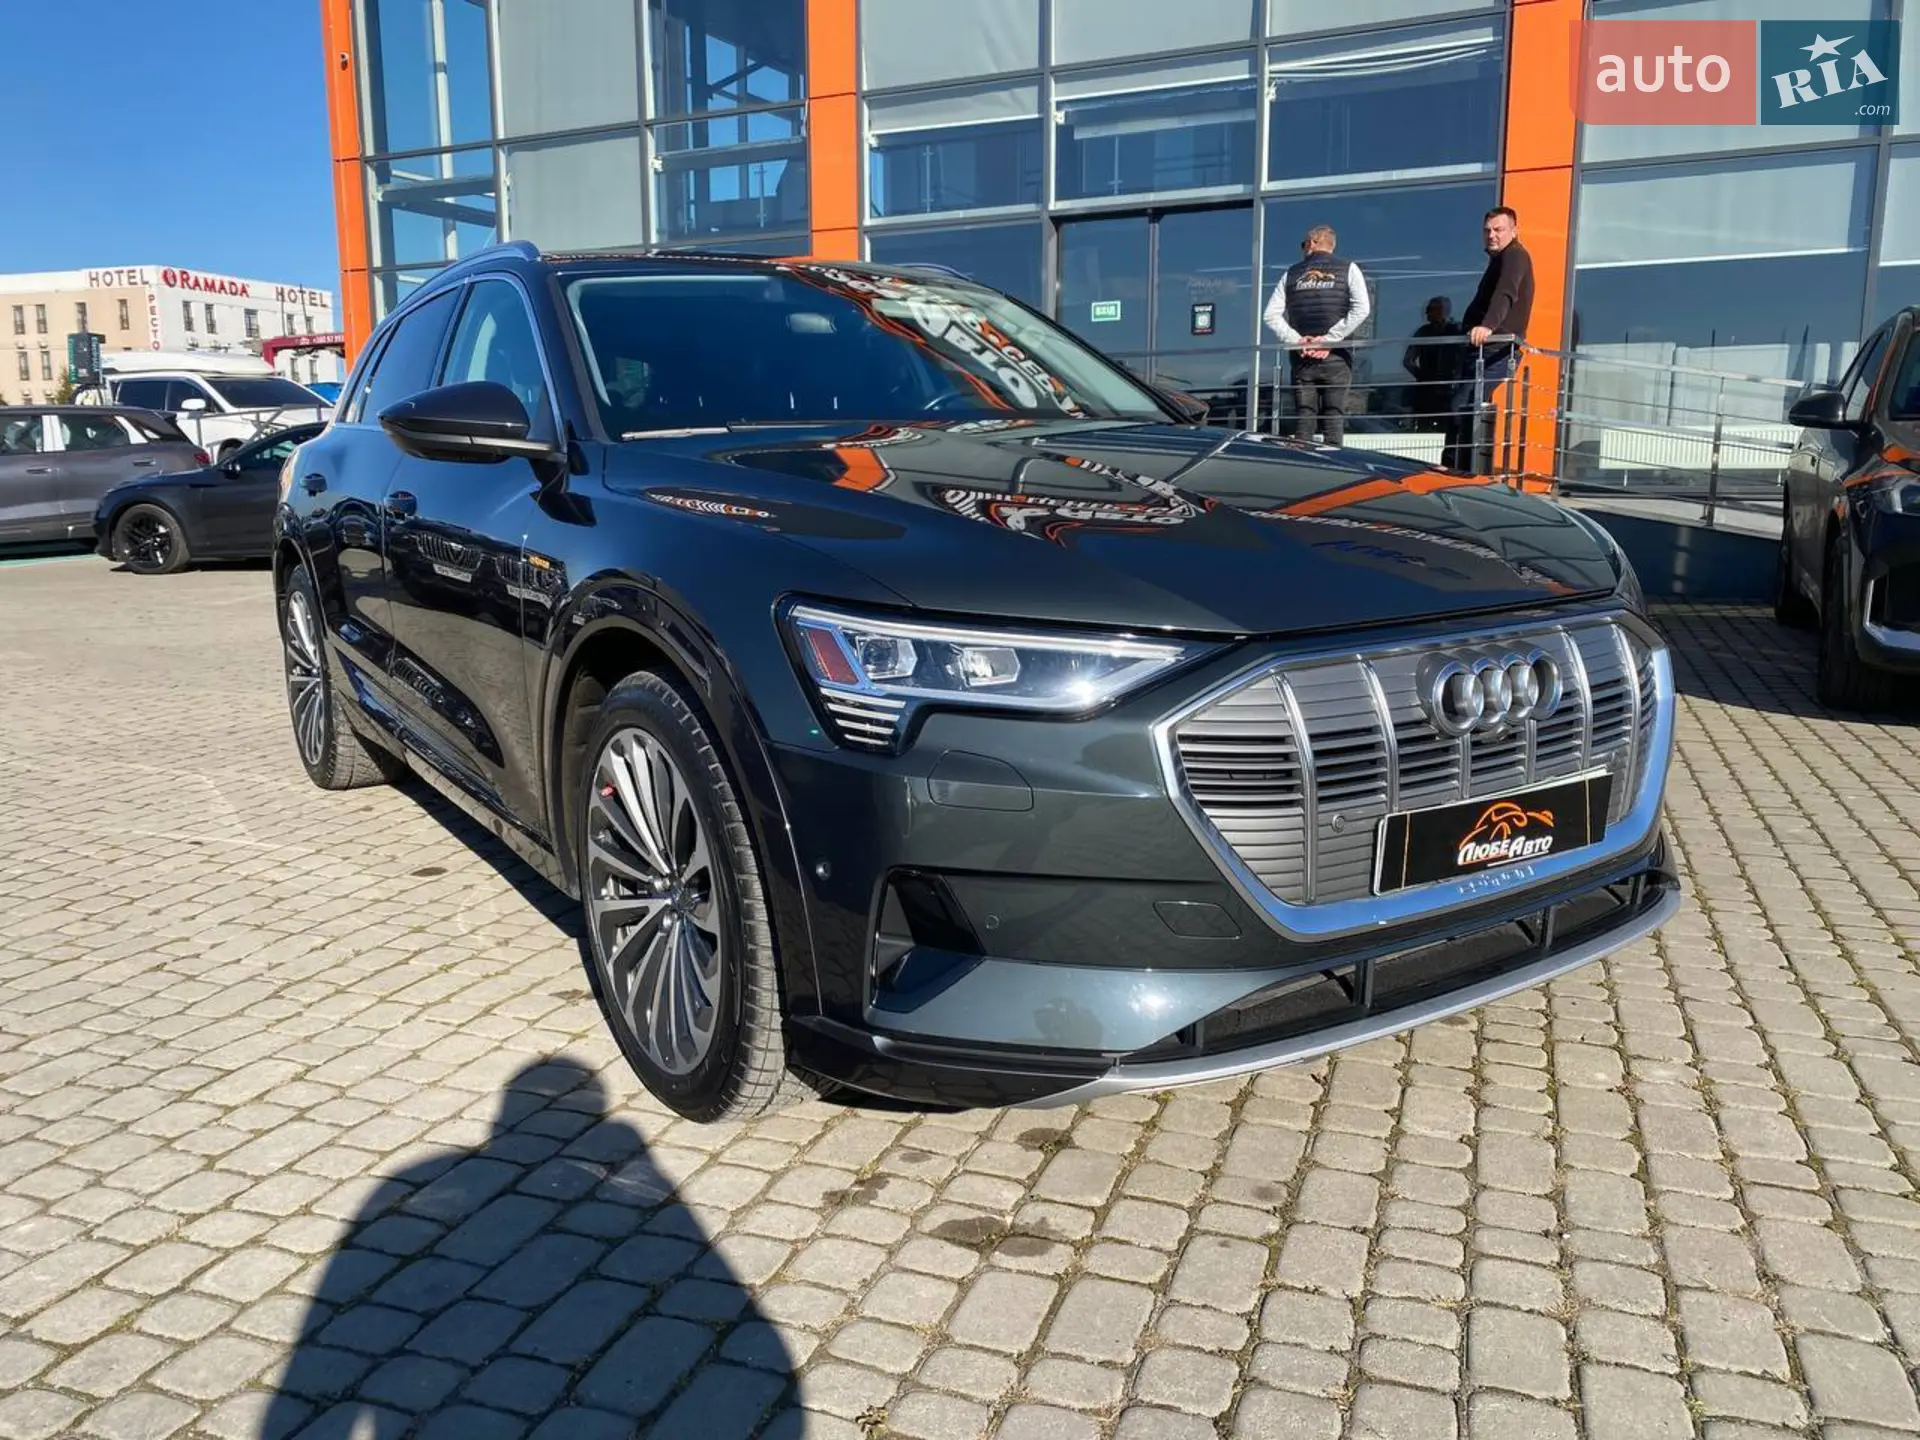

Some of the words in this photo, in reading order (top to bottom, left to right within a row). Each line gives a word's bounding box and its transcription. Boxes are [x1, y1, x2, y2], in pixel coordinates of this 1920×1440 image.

[88, 268, 150, 288] HOTEL
[179, 270, 250, 298] RAMADA
[275, 286, 329, 308] HOTEL
